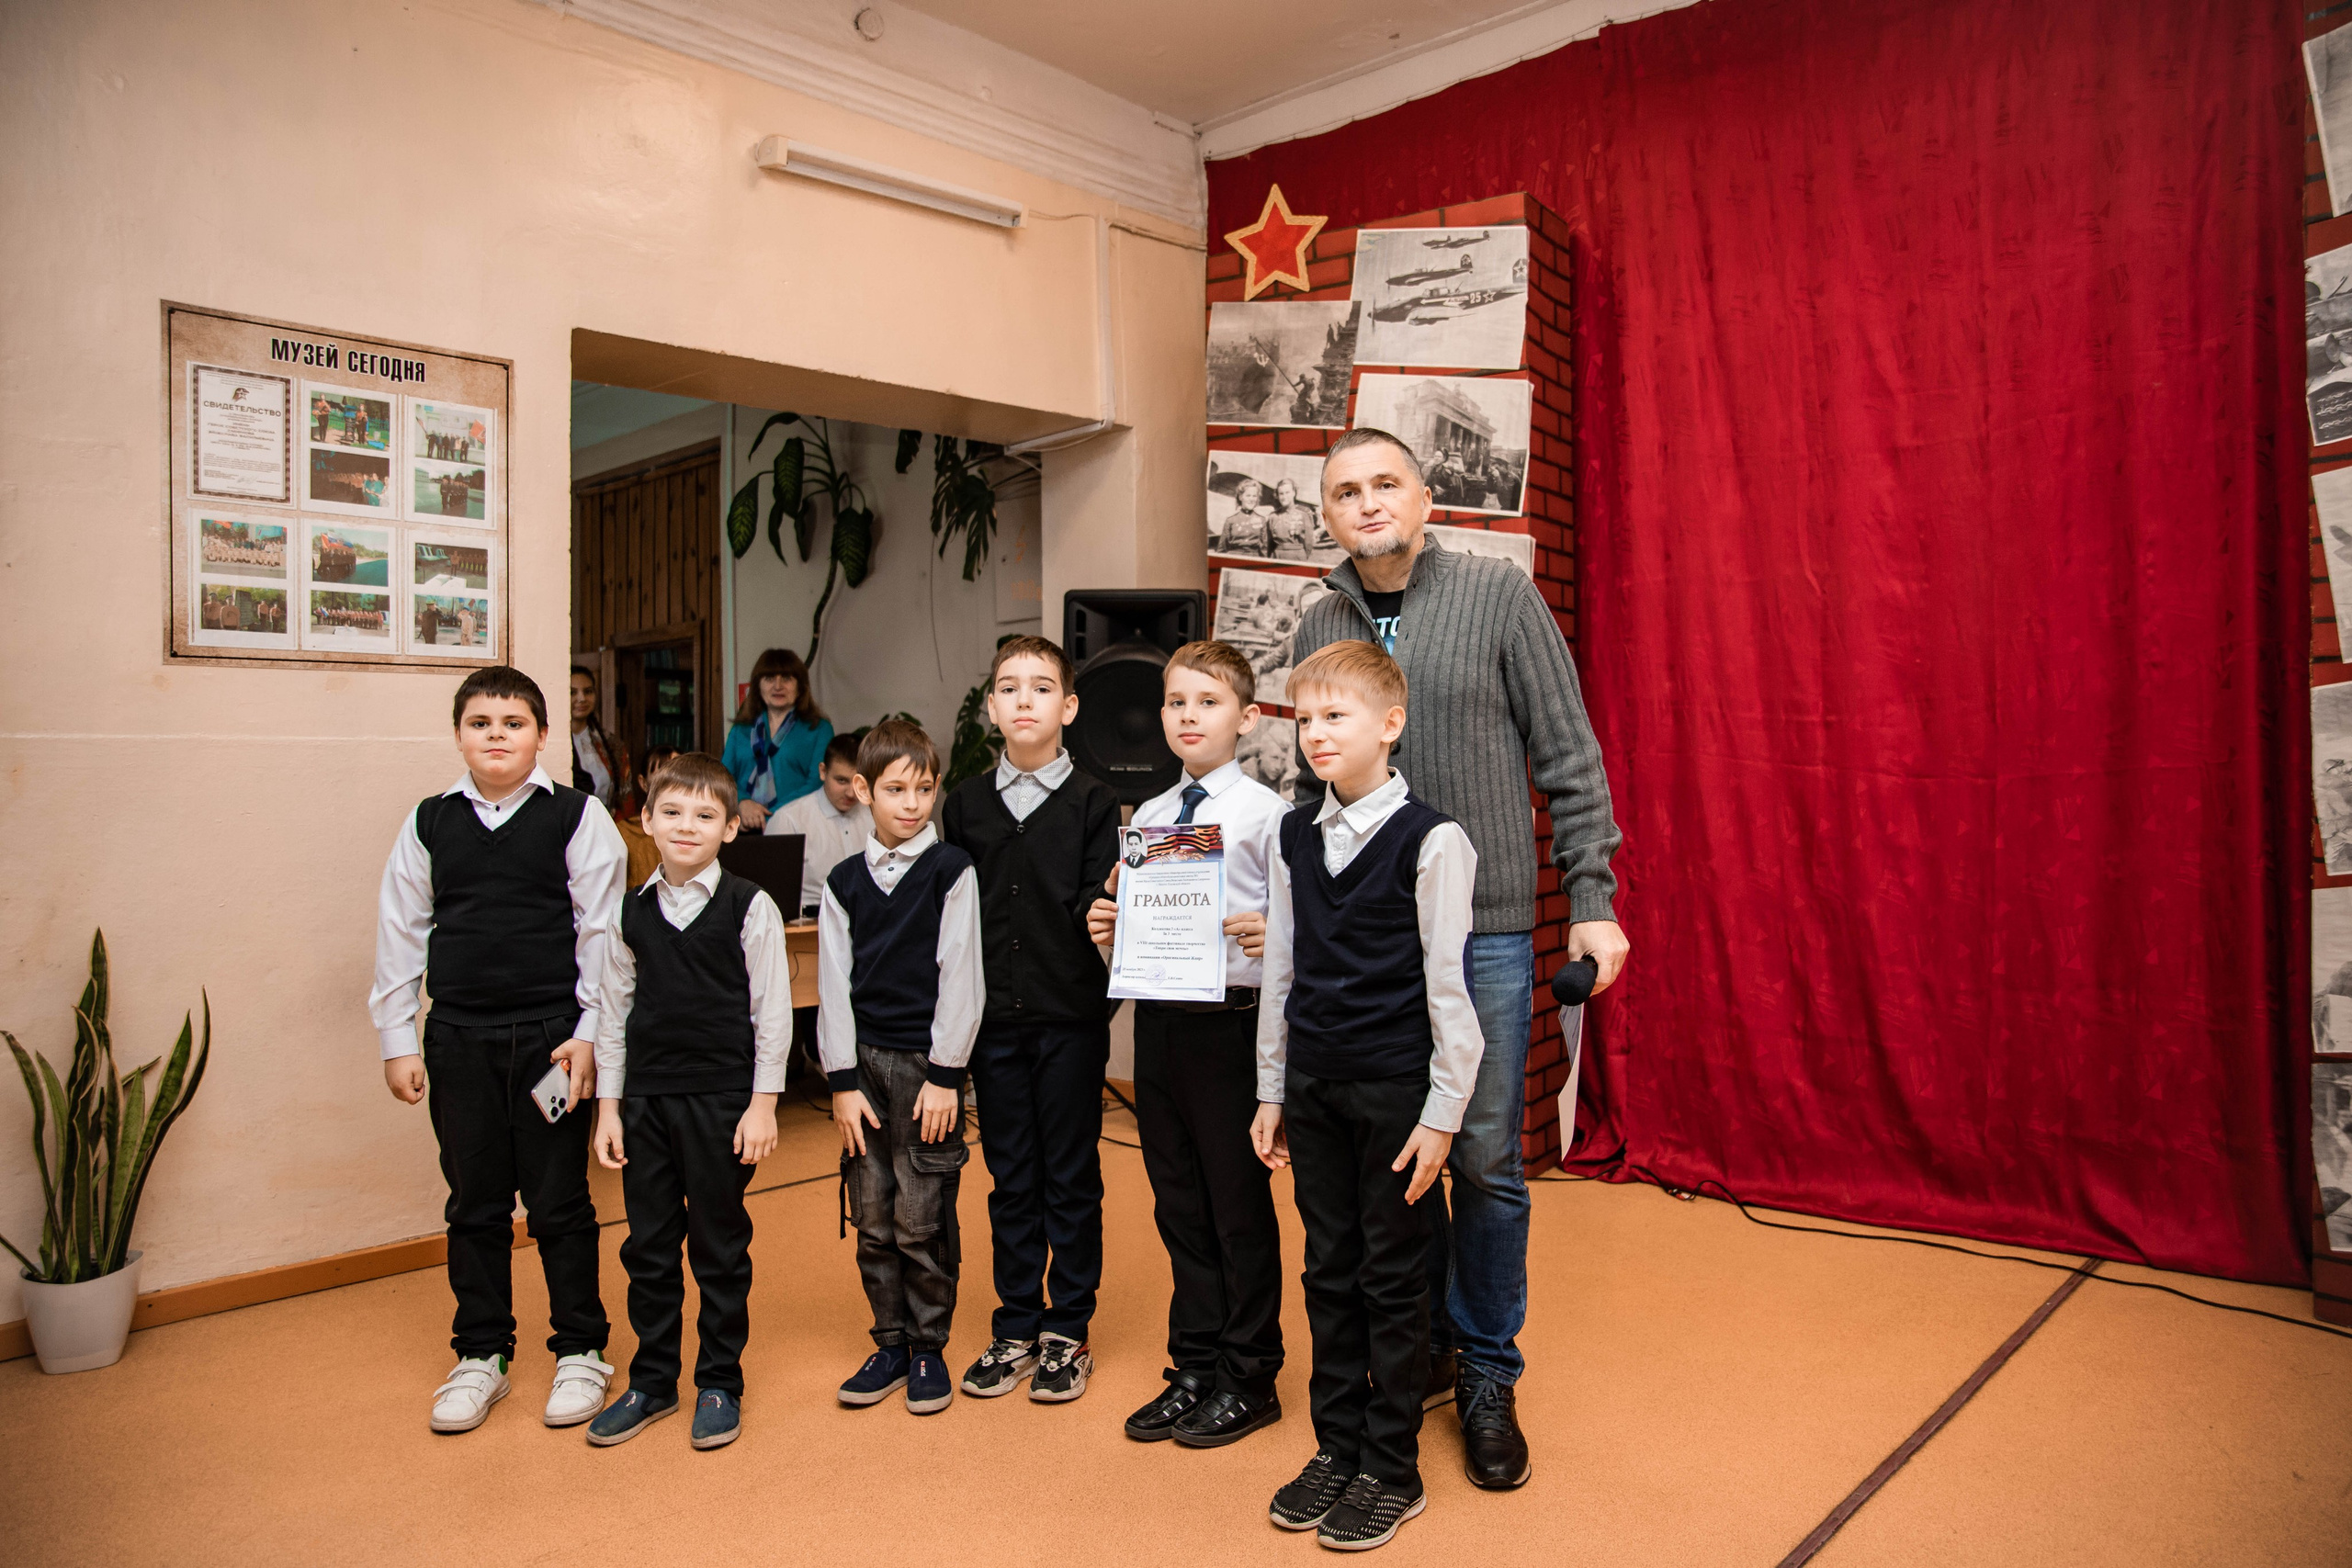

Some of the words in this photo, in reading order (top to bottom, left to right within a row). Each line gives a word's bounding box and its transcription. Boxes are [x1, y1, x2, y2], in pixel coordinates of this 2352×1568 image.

[1470, 291, 1481, 304] 25
[271, 338, 339, 369] МУЗЕЙ
[348, 351, 425, 383] СЕГОДНЯ
[203, 400, 281, 417] СВИДЕТЕЛЬСТВО
[1133, 893, 1211, 907] ГРАМОТА
